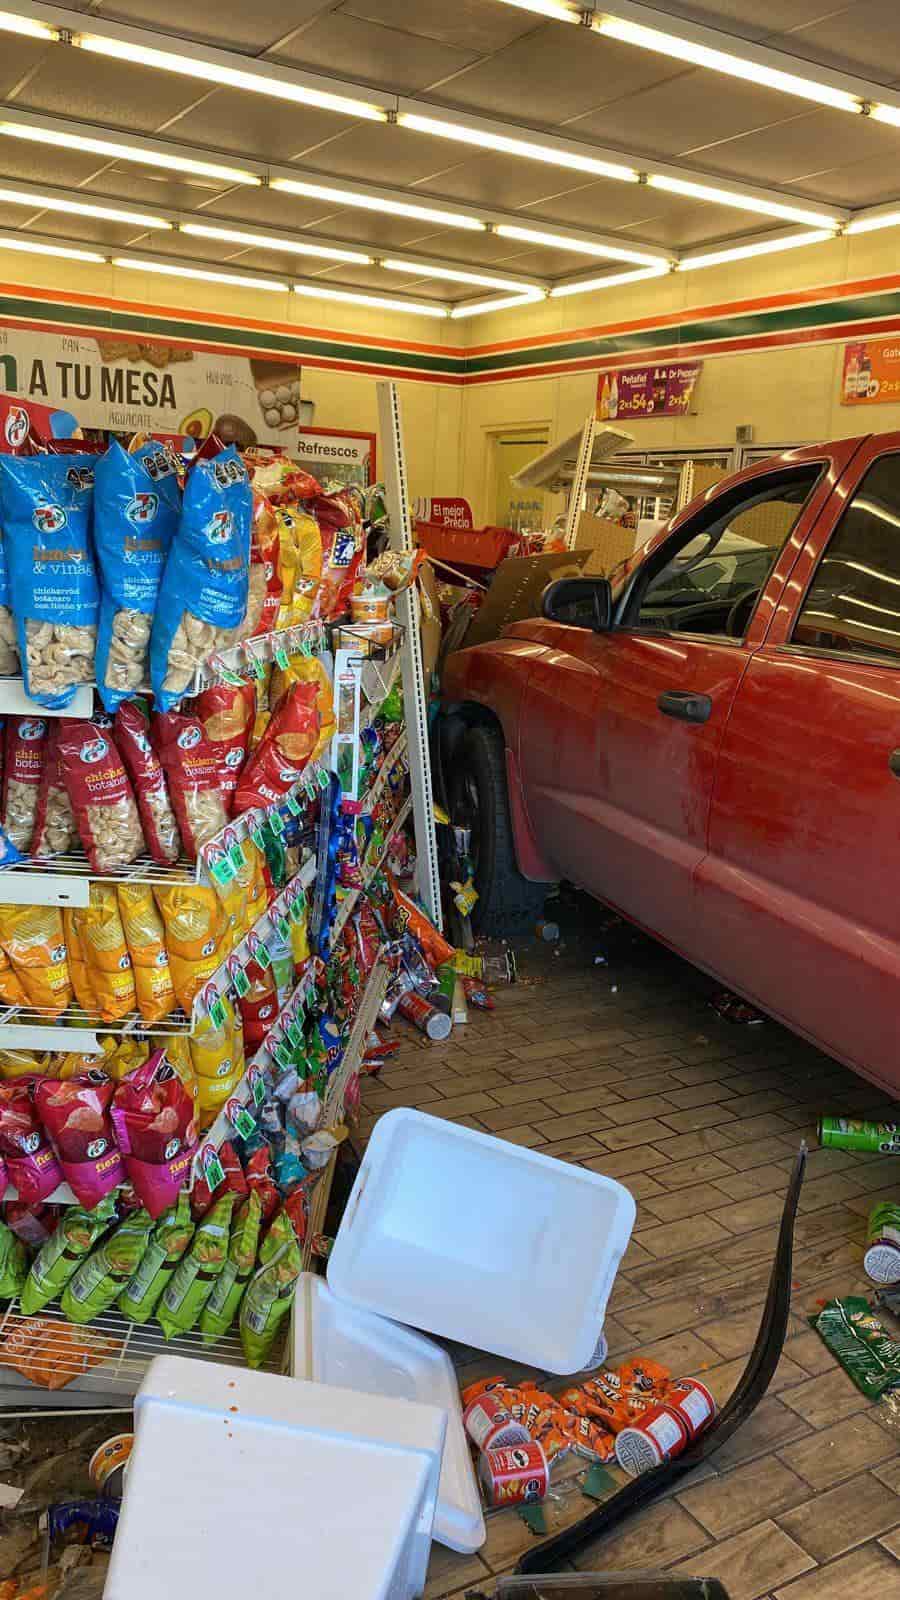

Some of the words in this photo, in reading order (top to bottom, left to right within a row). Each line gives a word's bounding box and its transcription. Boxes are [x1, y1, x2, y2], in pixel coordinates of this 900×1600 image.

[29, 359, 48, 396] A
[56, 361, 91, 401] TU
[100, 366, 177, 410] MESA
[297, 441, 359, 458] Refrescos
[433, 504, 441, 516] El
[443, 516, 470, 529] Precio
